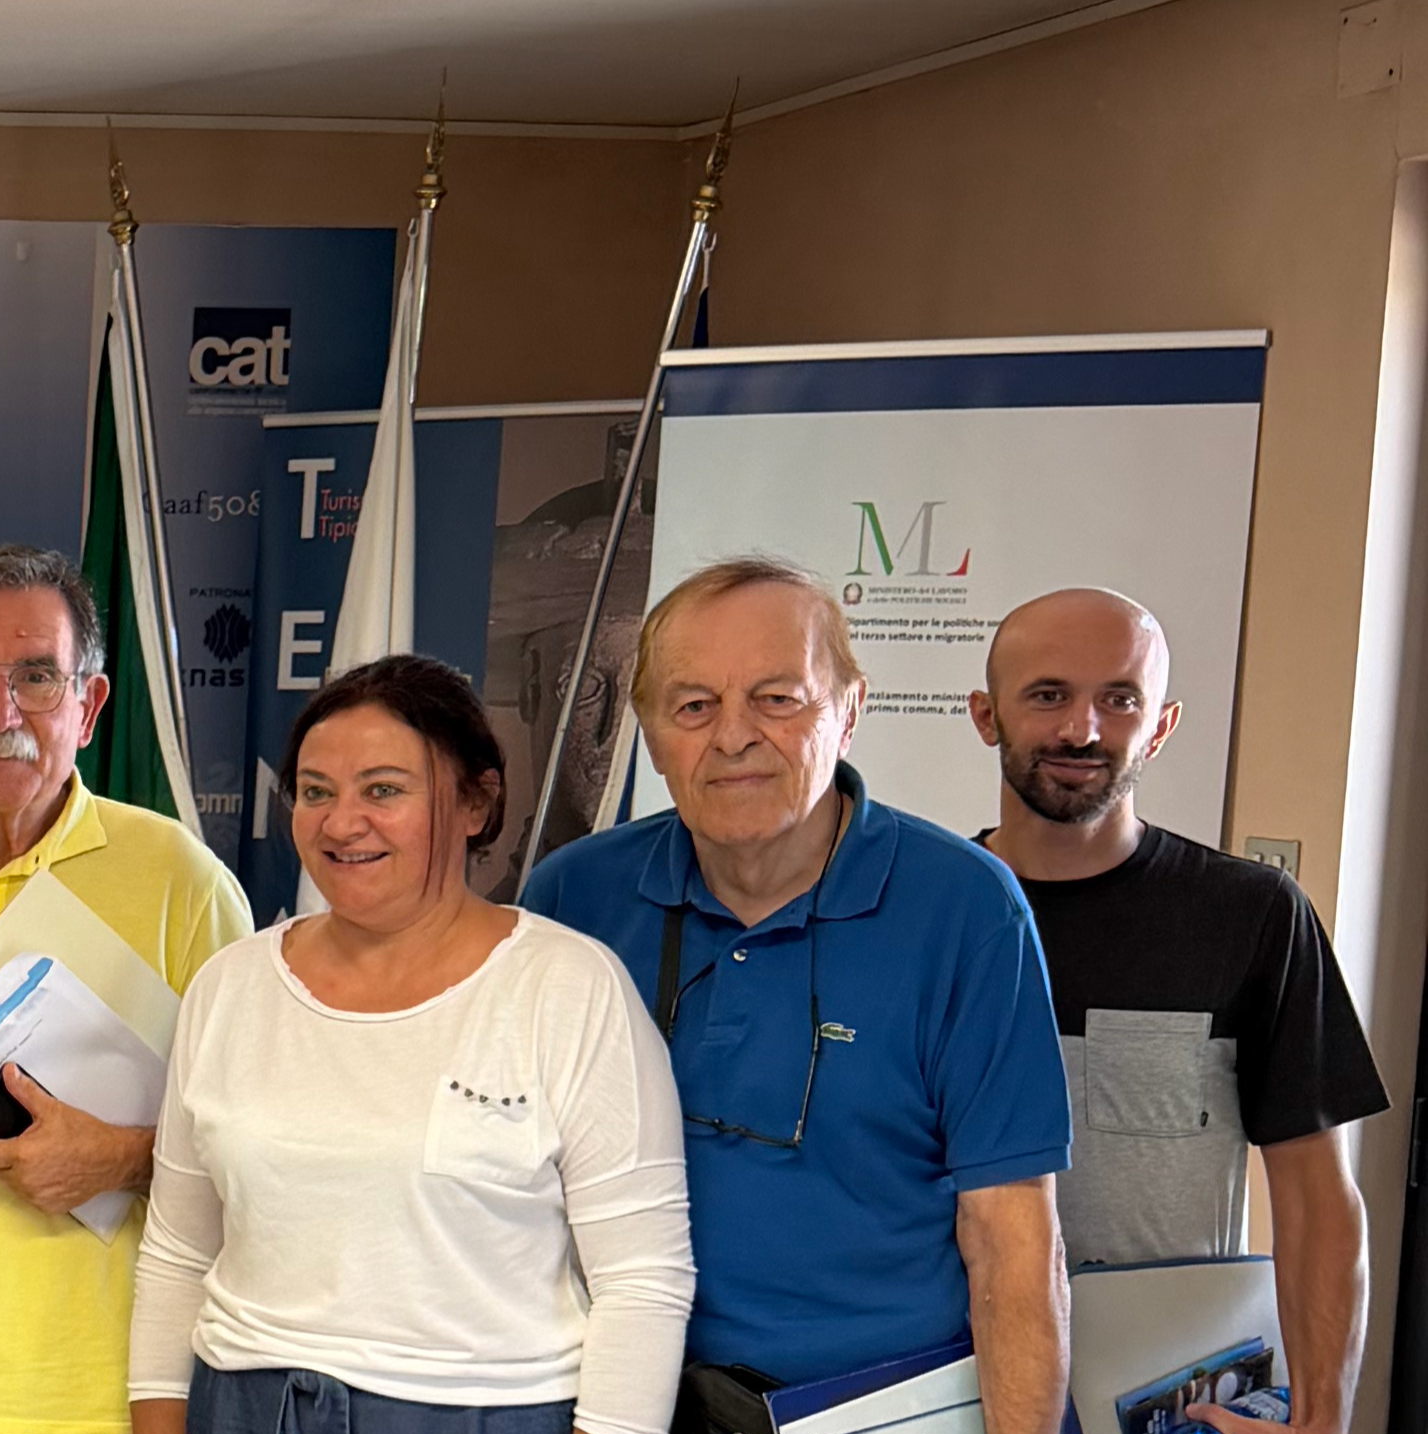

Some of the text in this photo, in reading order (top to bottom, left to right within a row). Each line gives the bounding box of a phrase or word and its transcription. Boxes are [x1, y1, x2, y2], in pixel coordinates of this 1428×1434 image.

[189, 325, 290, 388] cat
[288, 458, 335, 539] T
[320, 488, 362, 511] Turis
[189, 588, 251, 598] PATRONA
[912, 619, 928, 628] per
[932, 617, 940, 627] le
[943, 617, 984, 628] politiche
[861, 632, 885, 640] terzo
[889, 632, 923, 641] settore
[934, 632, 985, 643] migratorie
[277, 610, 325, 690] E
[866, 704, 899, 714] primo
[950, 704, 966, 714] del
